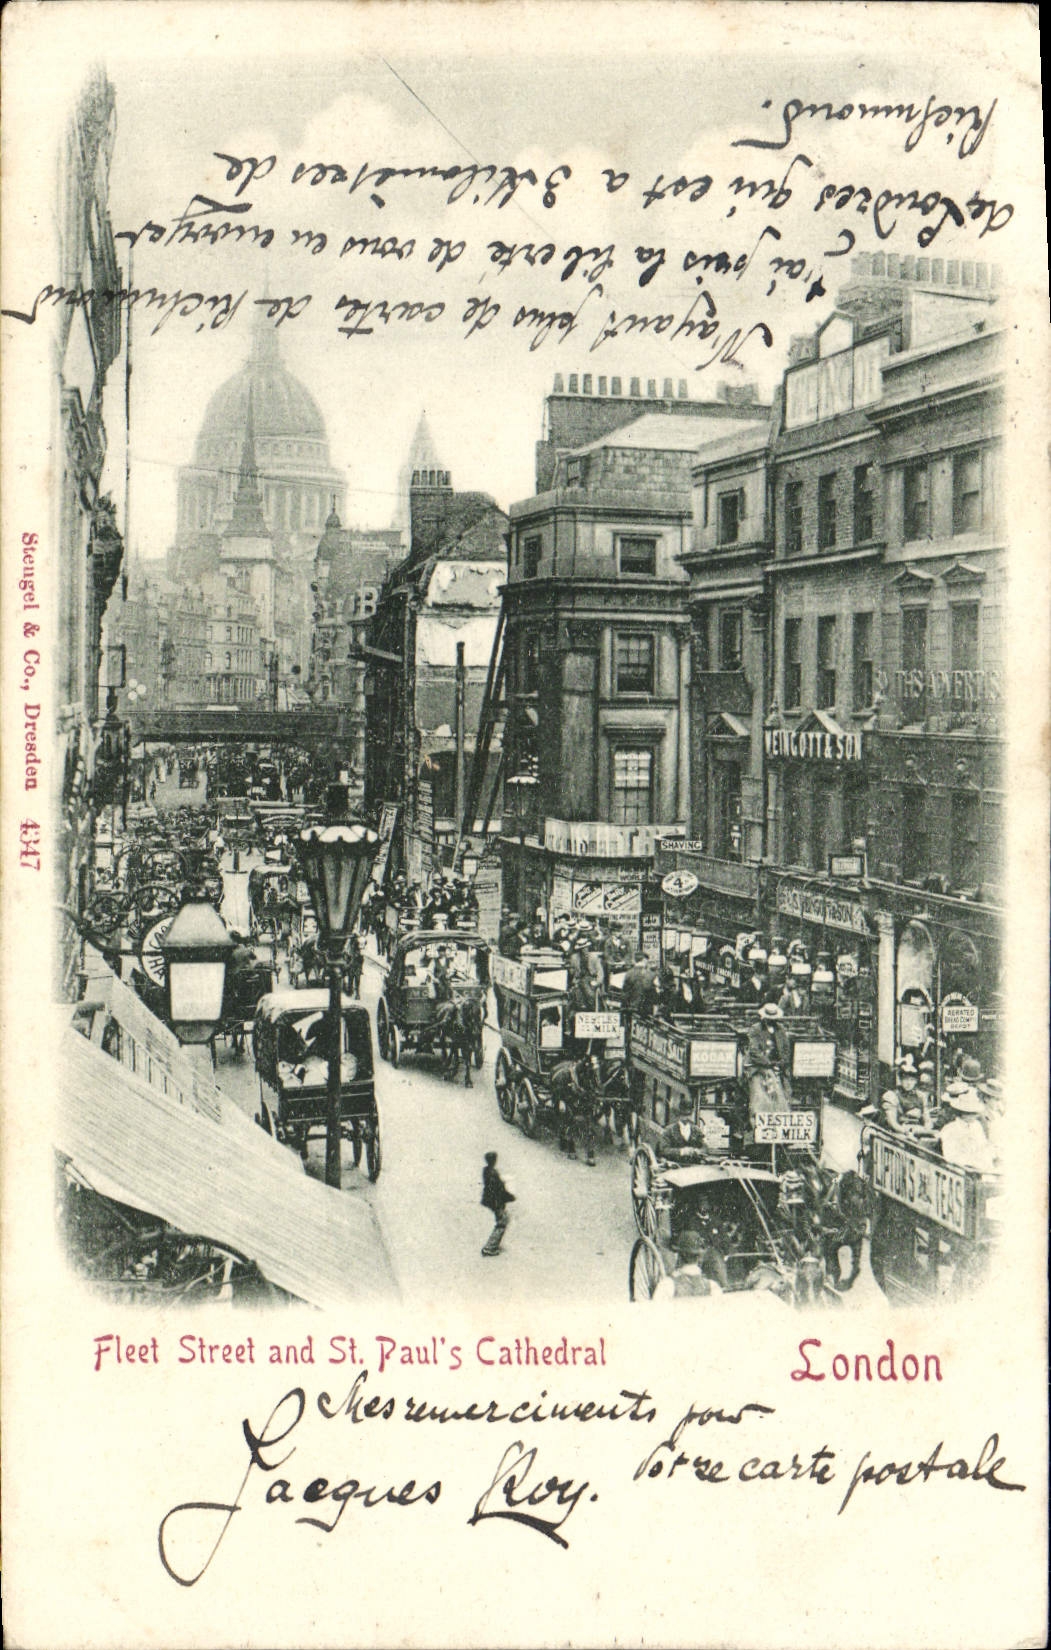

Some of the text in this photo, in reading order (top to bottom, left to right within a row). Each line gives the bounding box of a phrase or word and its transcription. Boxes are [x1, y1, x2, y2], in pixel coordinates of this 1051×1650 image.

[213, 152, 278, 197] de
[542, 165, 572, 209] 3
[642, 173, 714, 210] est
[726, 153, 813, 218] qui
[114, 193, 275, 249] envoyer
[813, 182, 963, 248] Londres
[958, 189, 1016, 238] de
[291, 228, 329, 256] en
[340, 234, 416, 260] vous
[428, 237, 467, 272] de
[684, 226, 781, 284] pris
[635, 245, 665, 287] la
[1, 284, 250, 336] Richmond
[254, 293, 312, 319] de
[464, 297, 502, 339] de
[513, 282, 604, 351] plus
[836, 733, 862, 760] SON
[781, 1128, 812, 1141] MILK
[158, 1386, 443, 1588] Jacques
[737, 1444, 837, 1485] carte
[837, 1432, 1027, 1516] postale
